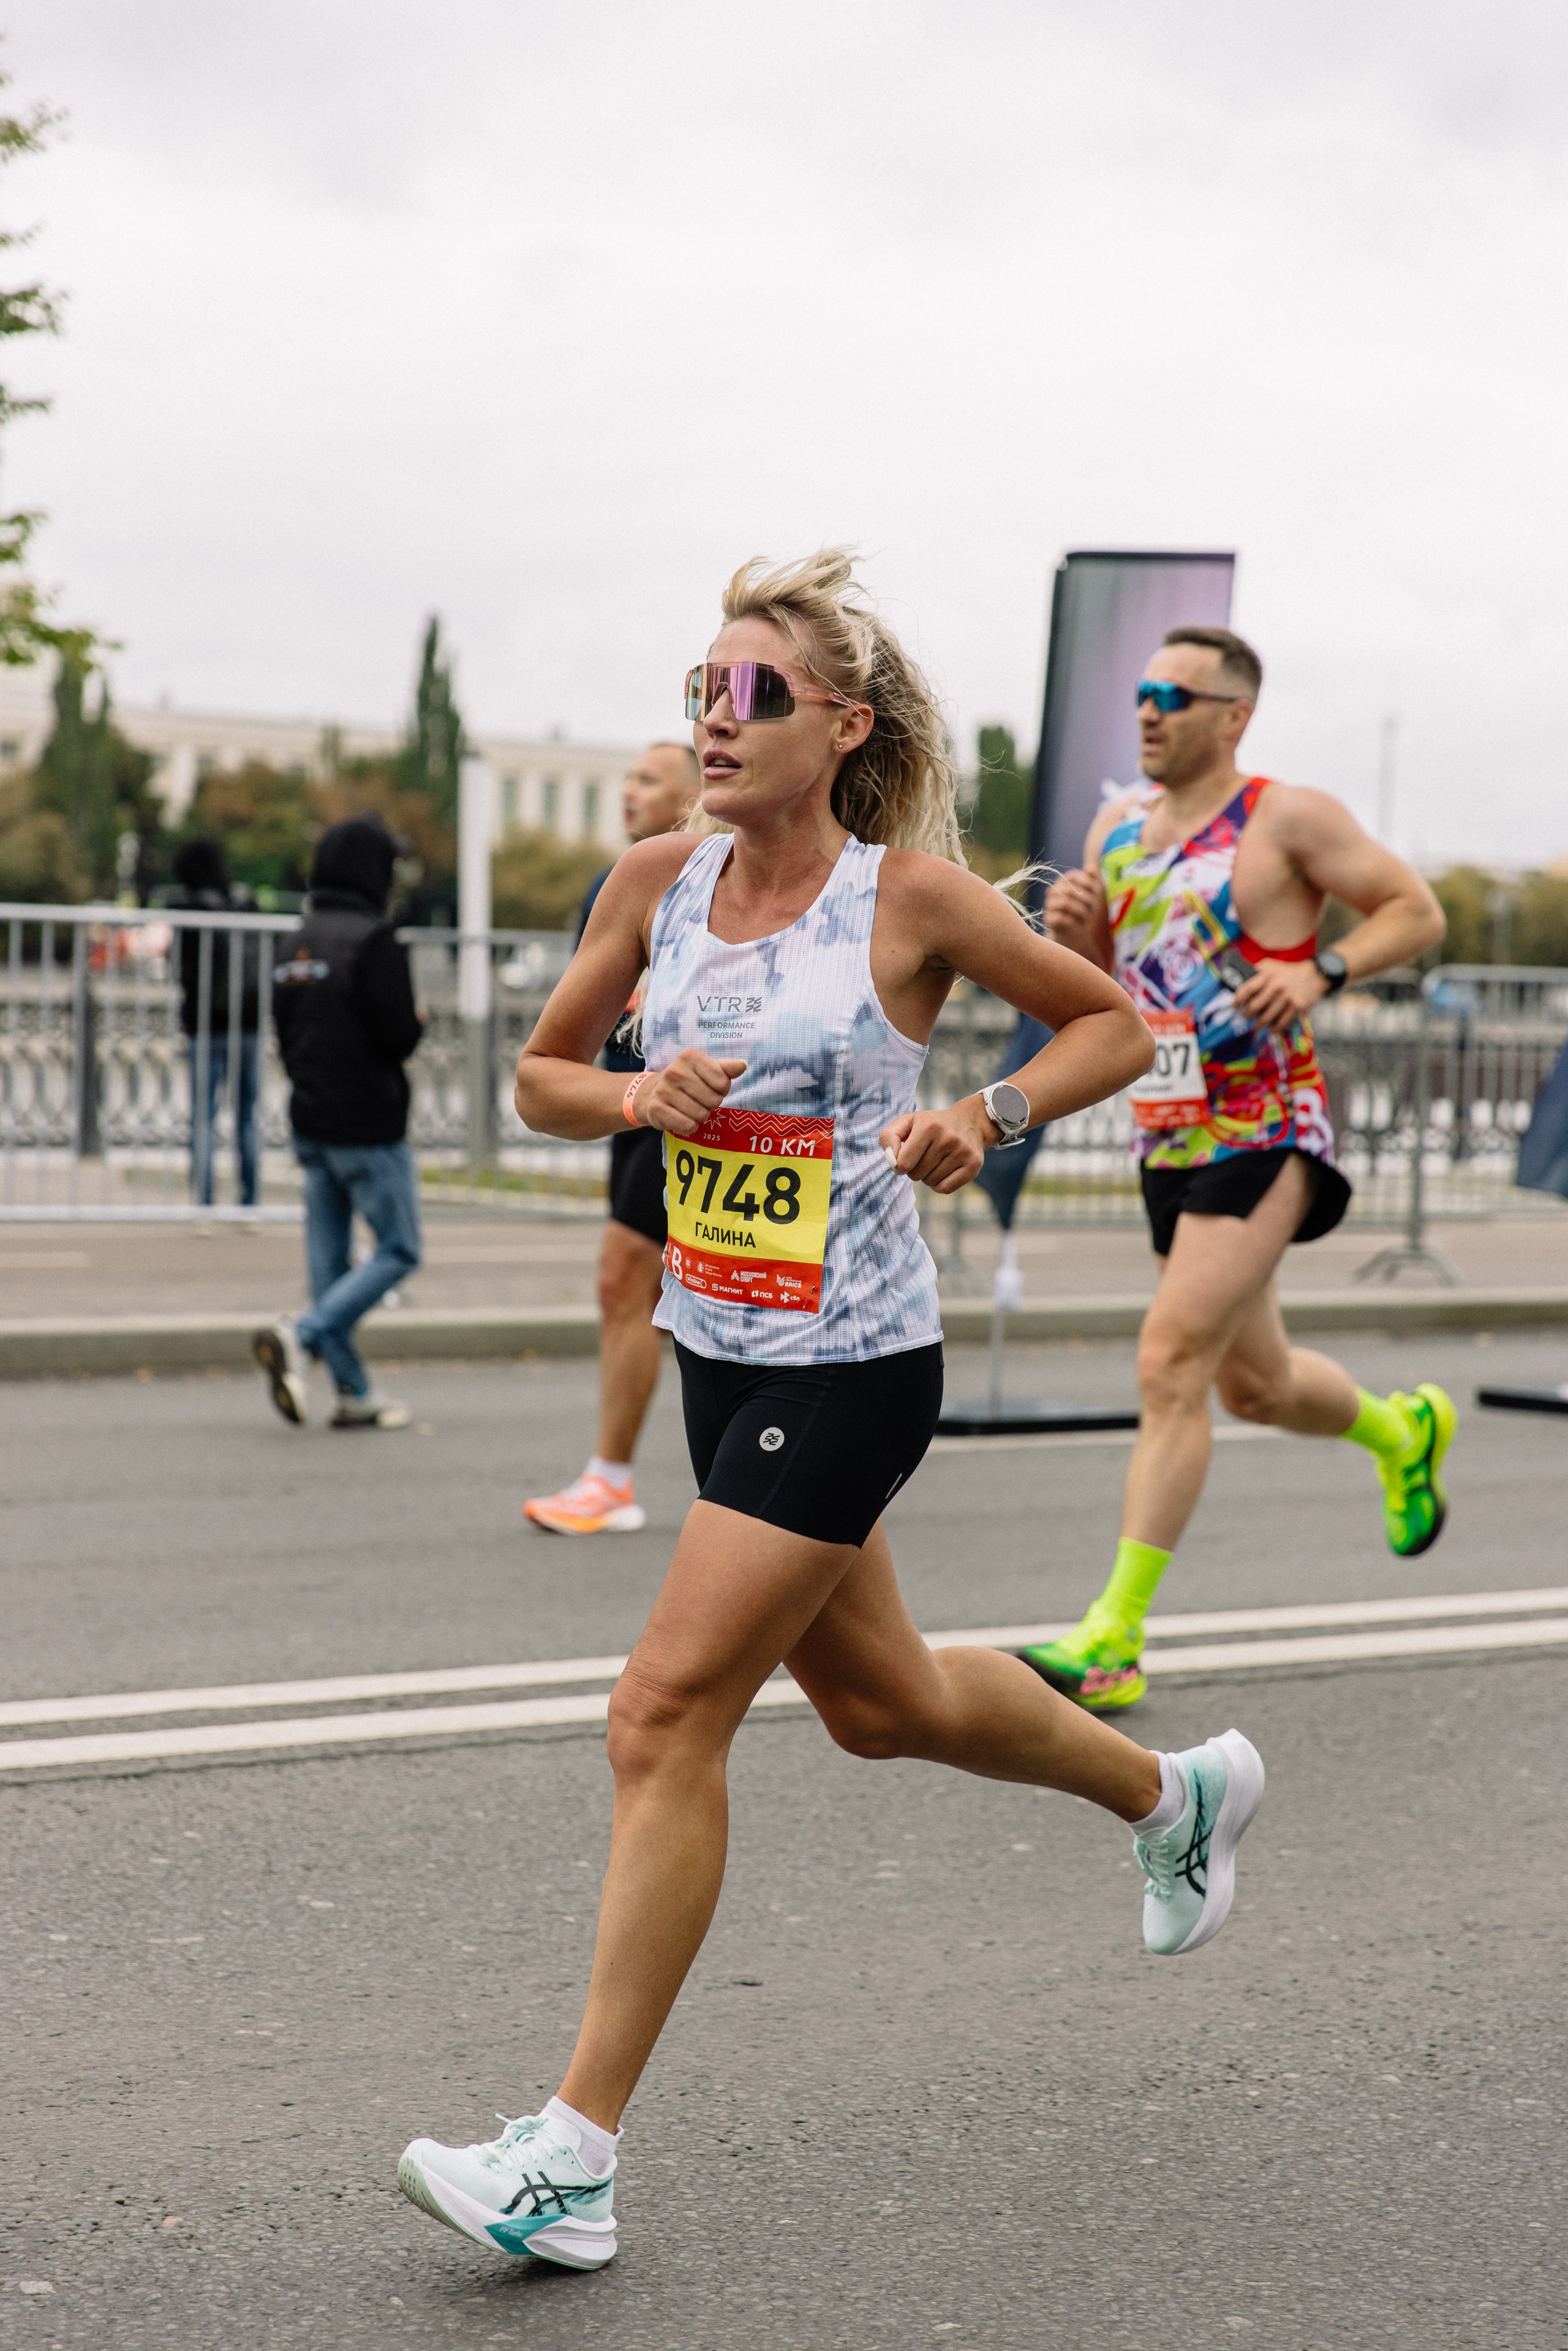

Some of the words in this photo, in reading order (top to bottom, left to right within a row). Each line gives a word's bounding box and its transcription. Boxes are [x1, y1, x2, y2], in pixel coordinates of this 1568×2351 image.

[697, 995, 742, 1012] VTR
[1148, 1043, 1190, 1077] 07
[703, 1133, 721, 1141] 2025
[749, 1135, 773, 1153] 10
[780, 1138, 816, 1156] KM
[676, 1149, 801, 1225] 9748
[695, 1221, 756, 1248] ГАЛИНА
[687, 1276, 701, 1285] Winline
[740, 1270, 767, 1279] МОСКОВСКИЙ
[719, 1286, 744, 1295] МАГНИТ
